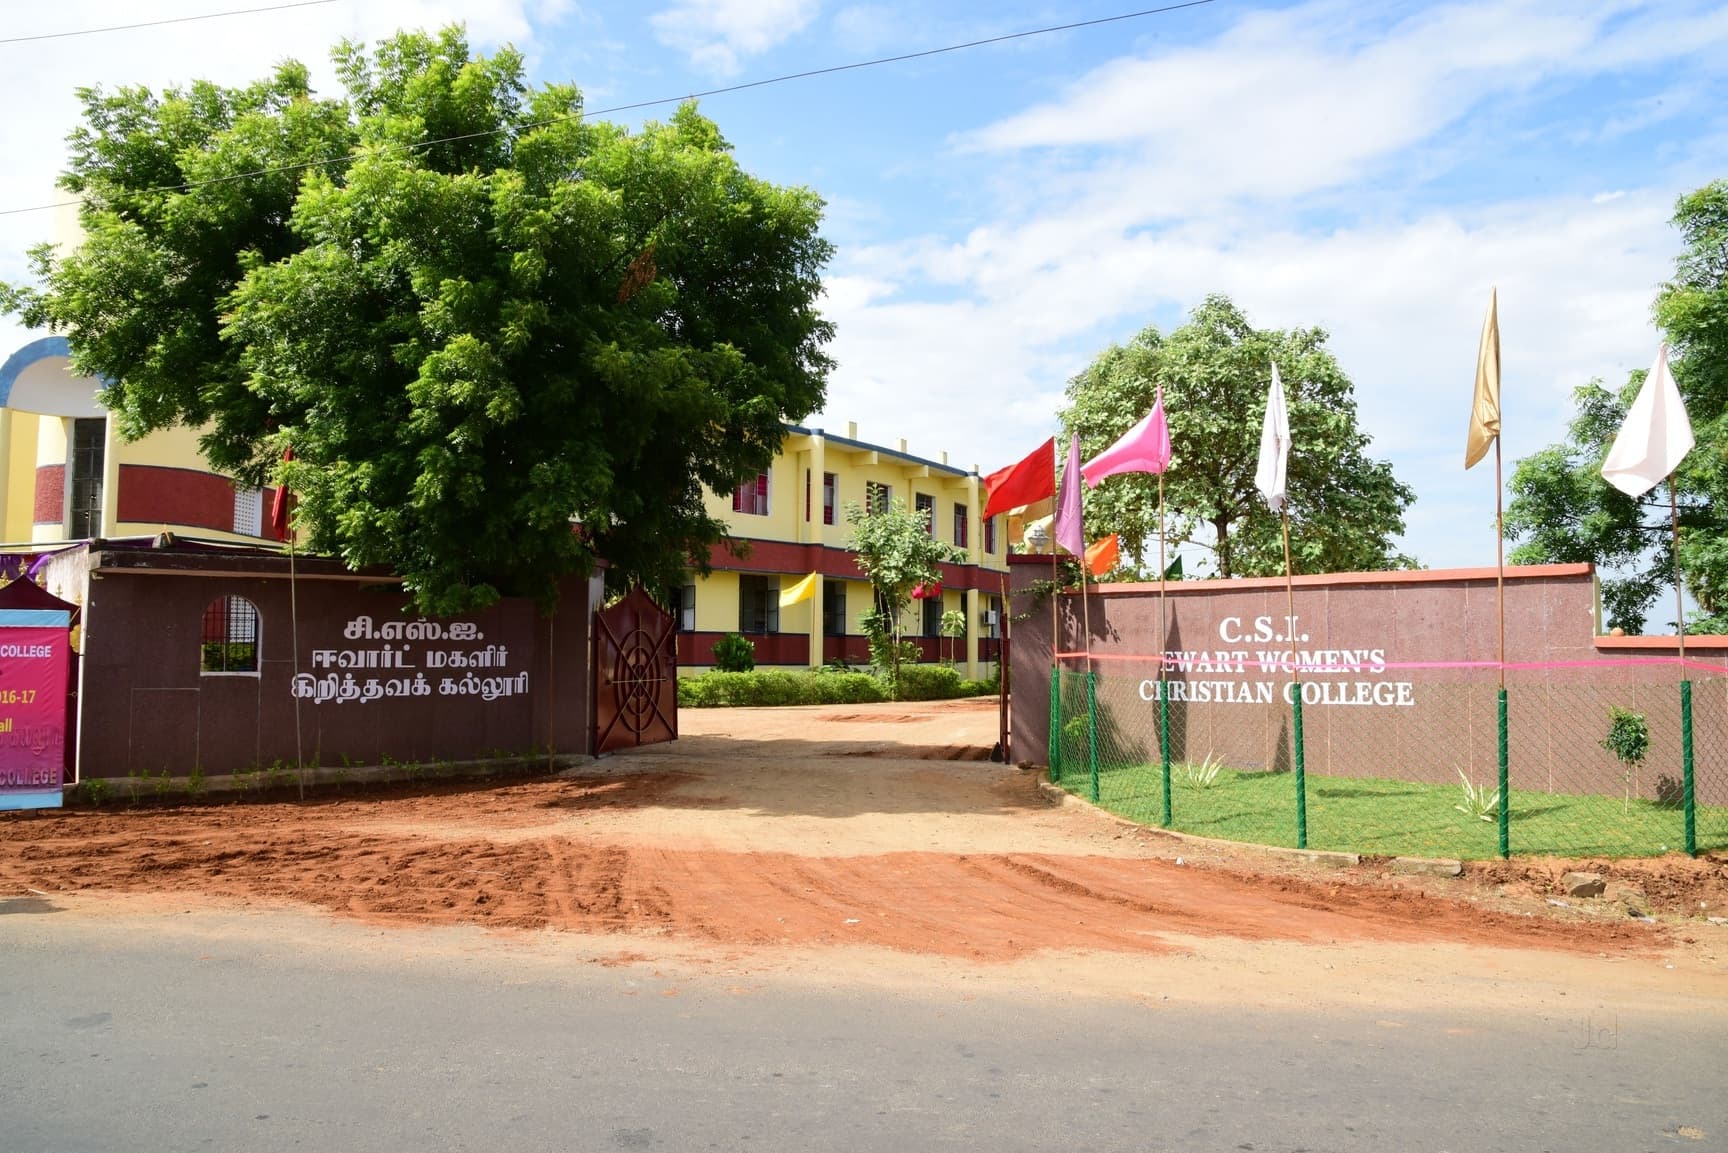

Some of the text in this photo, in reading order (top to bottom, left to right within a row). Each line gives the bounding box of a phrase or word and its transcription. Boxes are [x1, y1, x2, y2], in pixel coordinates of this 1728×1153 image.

[1219, 615, 1309, 643] C.S.I.
[0, 644, 52, 658] COLLEGE
[312, 643, 509, 668] ஈவார்ட் மகளிர்
[1160, 648, 1385, 674] EWART WOMEN'S
[0, 689, 36, 704] 16-17
[439, 671, 529, 701] கல்லூரி
